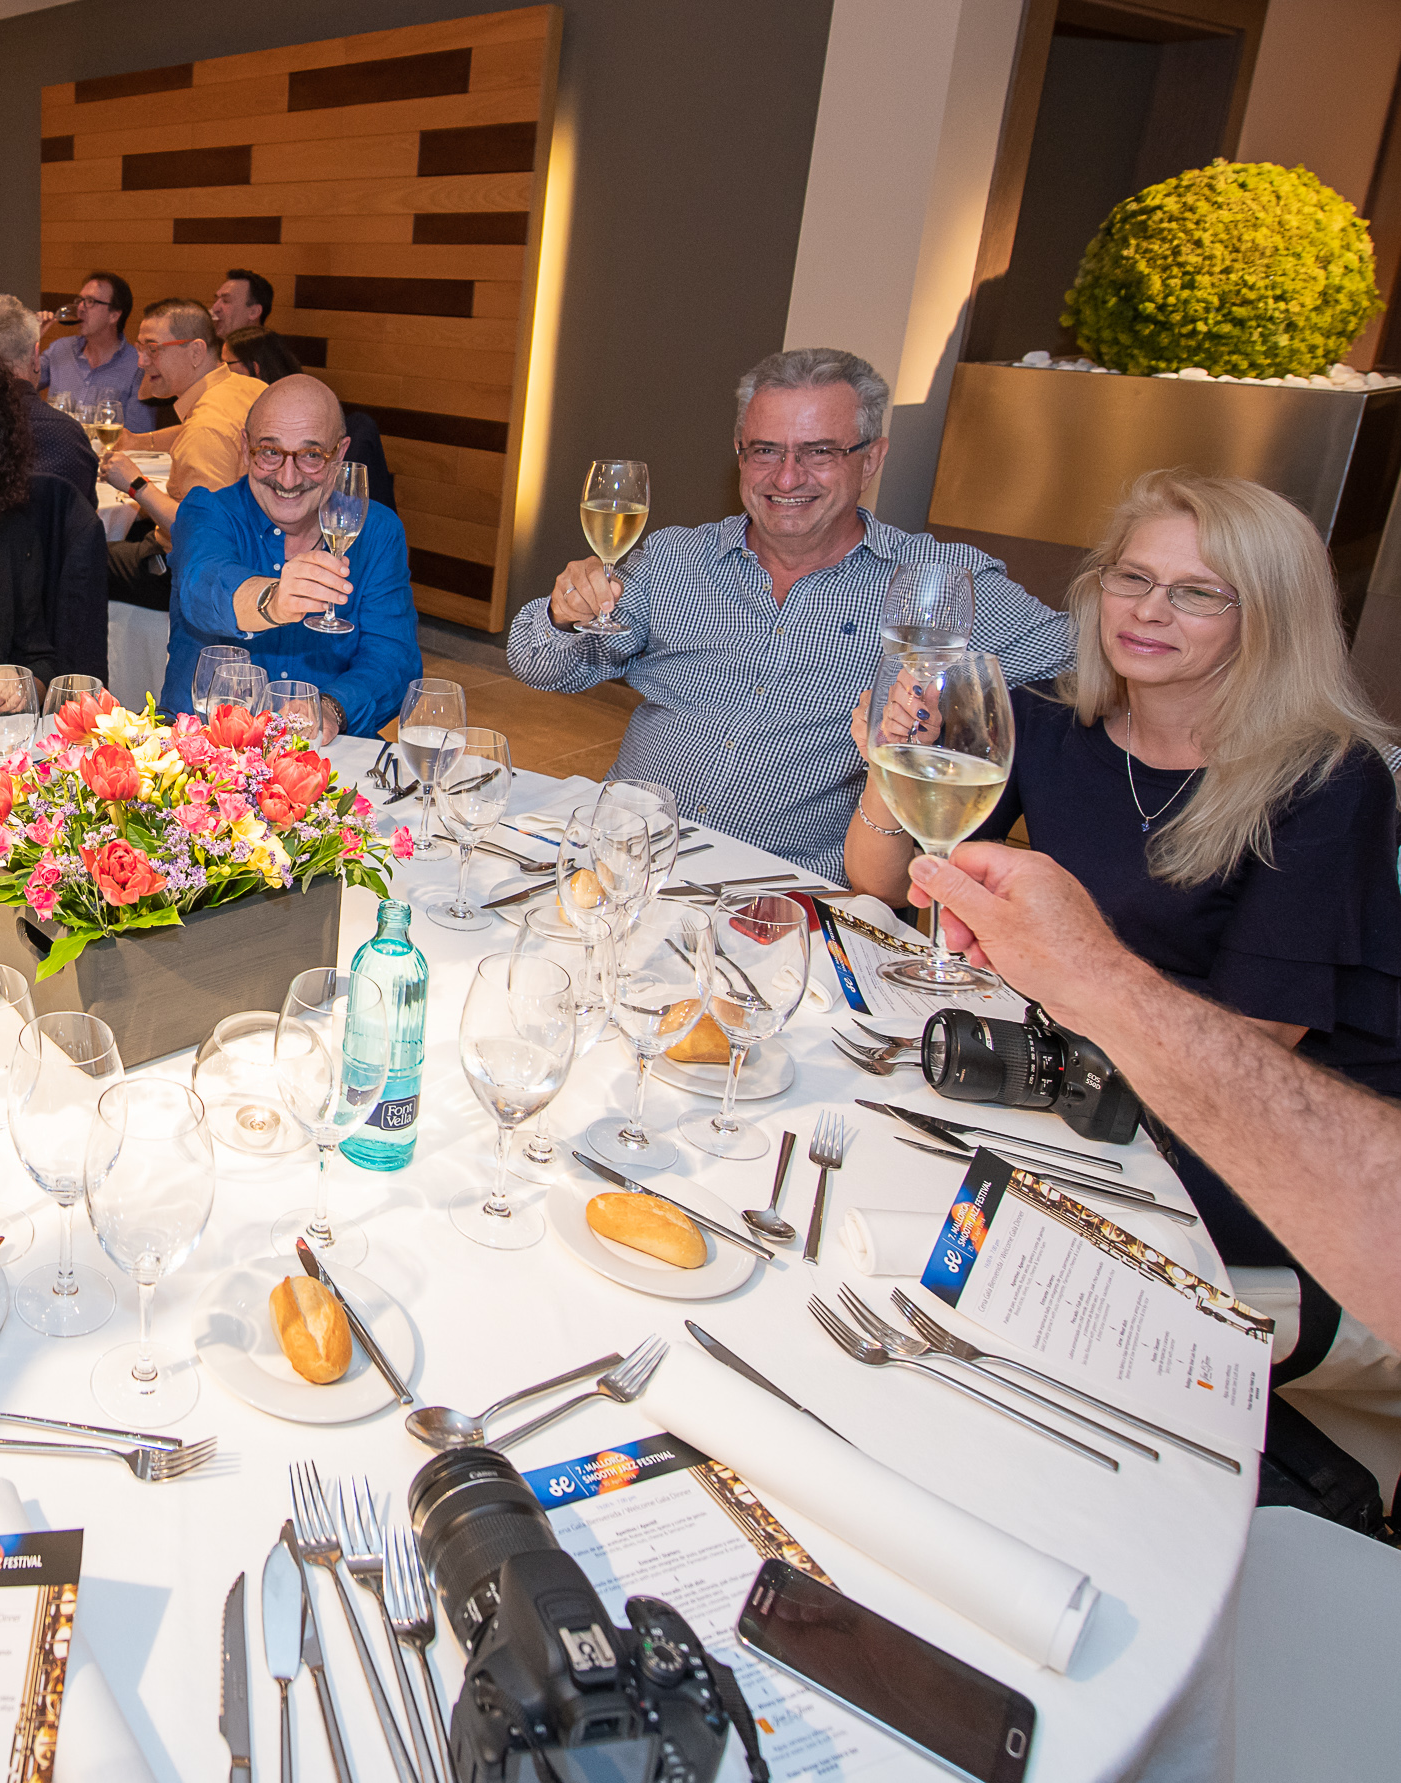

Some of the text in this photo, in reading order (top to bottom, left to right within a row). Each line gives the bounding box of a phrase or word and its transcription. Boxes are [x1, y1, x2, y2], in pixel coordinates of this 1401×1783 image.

[1085, 1078, 1101, 1089] 550D
[1087, 1072, 1101, 1083] EOS
[387, 1103, 412, 1116] Font
[386, 1114, 412, 1126] Vella
[951, 1203, 970, 1234] MALLORCA
[958, 1181, 991, 1246] SMOOTH JAZZ FESTIVAL
[1013, 1210, 1024, 1227] Dinner
[1009, 1226, 1018, 1237] Gala
[1000, 1237, 1014, 1259] Welcome
[988, 1262, 1003, 1288] Bienvenida
[983, 1288, 992, 1299] Gala
[978, 1299, 988, 1312] Cena
[575, 1454, 628, 1474] 7. MALLORCA
[582, 1451, 675, 1483] SMOOTH JAZZ FESTIVAL
[3, 1556, 42, 1568] FESTIVAL
